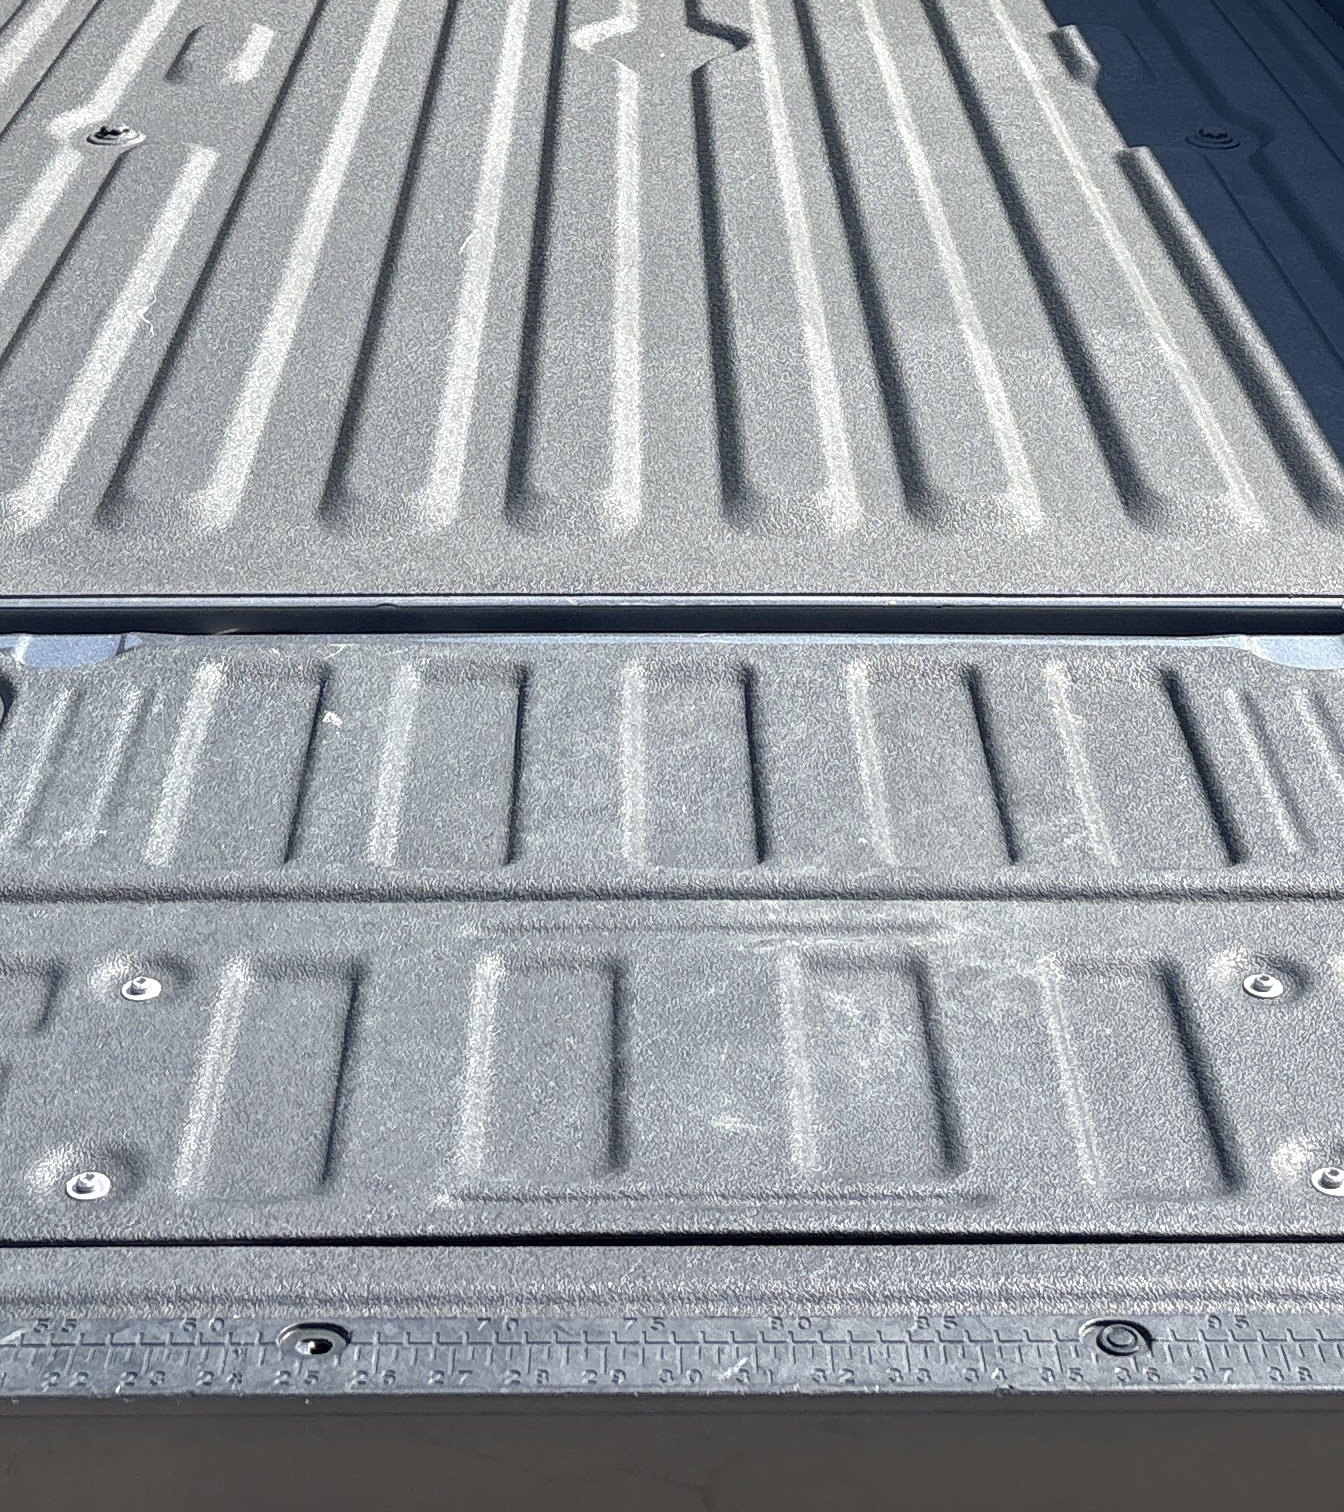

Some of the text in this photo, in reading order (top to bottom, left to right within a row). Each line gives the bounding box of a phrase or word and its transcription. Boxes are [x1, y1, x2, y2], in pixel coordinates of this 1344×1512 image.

[33, 1318, 77, 1334] 55
[181, 1317, 226, 1333] 60
[477, 1317, 520, 1332] 70
[623, 1317, 666, 1331] 75
[915, 1315, 959, 1331] 85
[1207, 1315, 1251, 1330] 95
[274, 1369, 320, 1385] 25
[350, 1369, 396, 1386] 26
[429, 1369, 473, 1385] 27
[504, 1369, 549, 1385] 28
[581, 1368, 626, 1384] 29
[659, 1368, 702, 1384] 30
[811, 1368, 855, 1384] 32
[888, 1368, 932, 1383] 33
[1039, 1367, 1084, 1383] 35
[1115, 1367, 1161, 1383] 36
[1191, 1367, 1234, 1382] 37
[1268, 1367, 1313, 1382] 38
